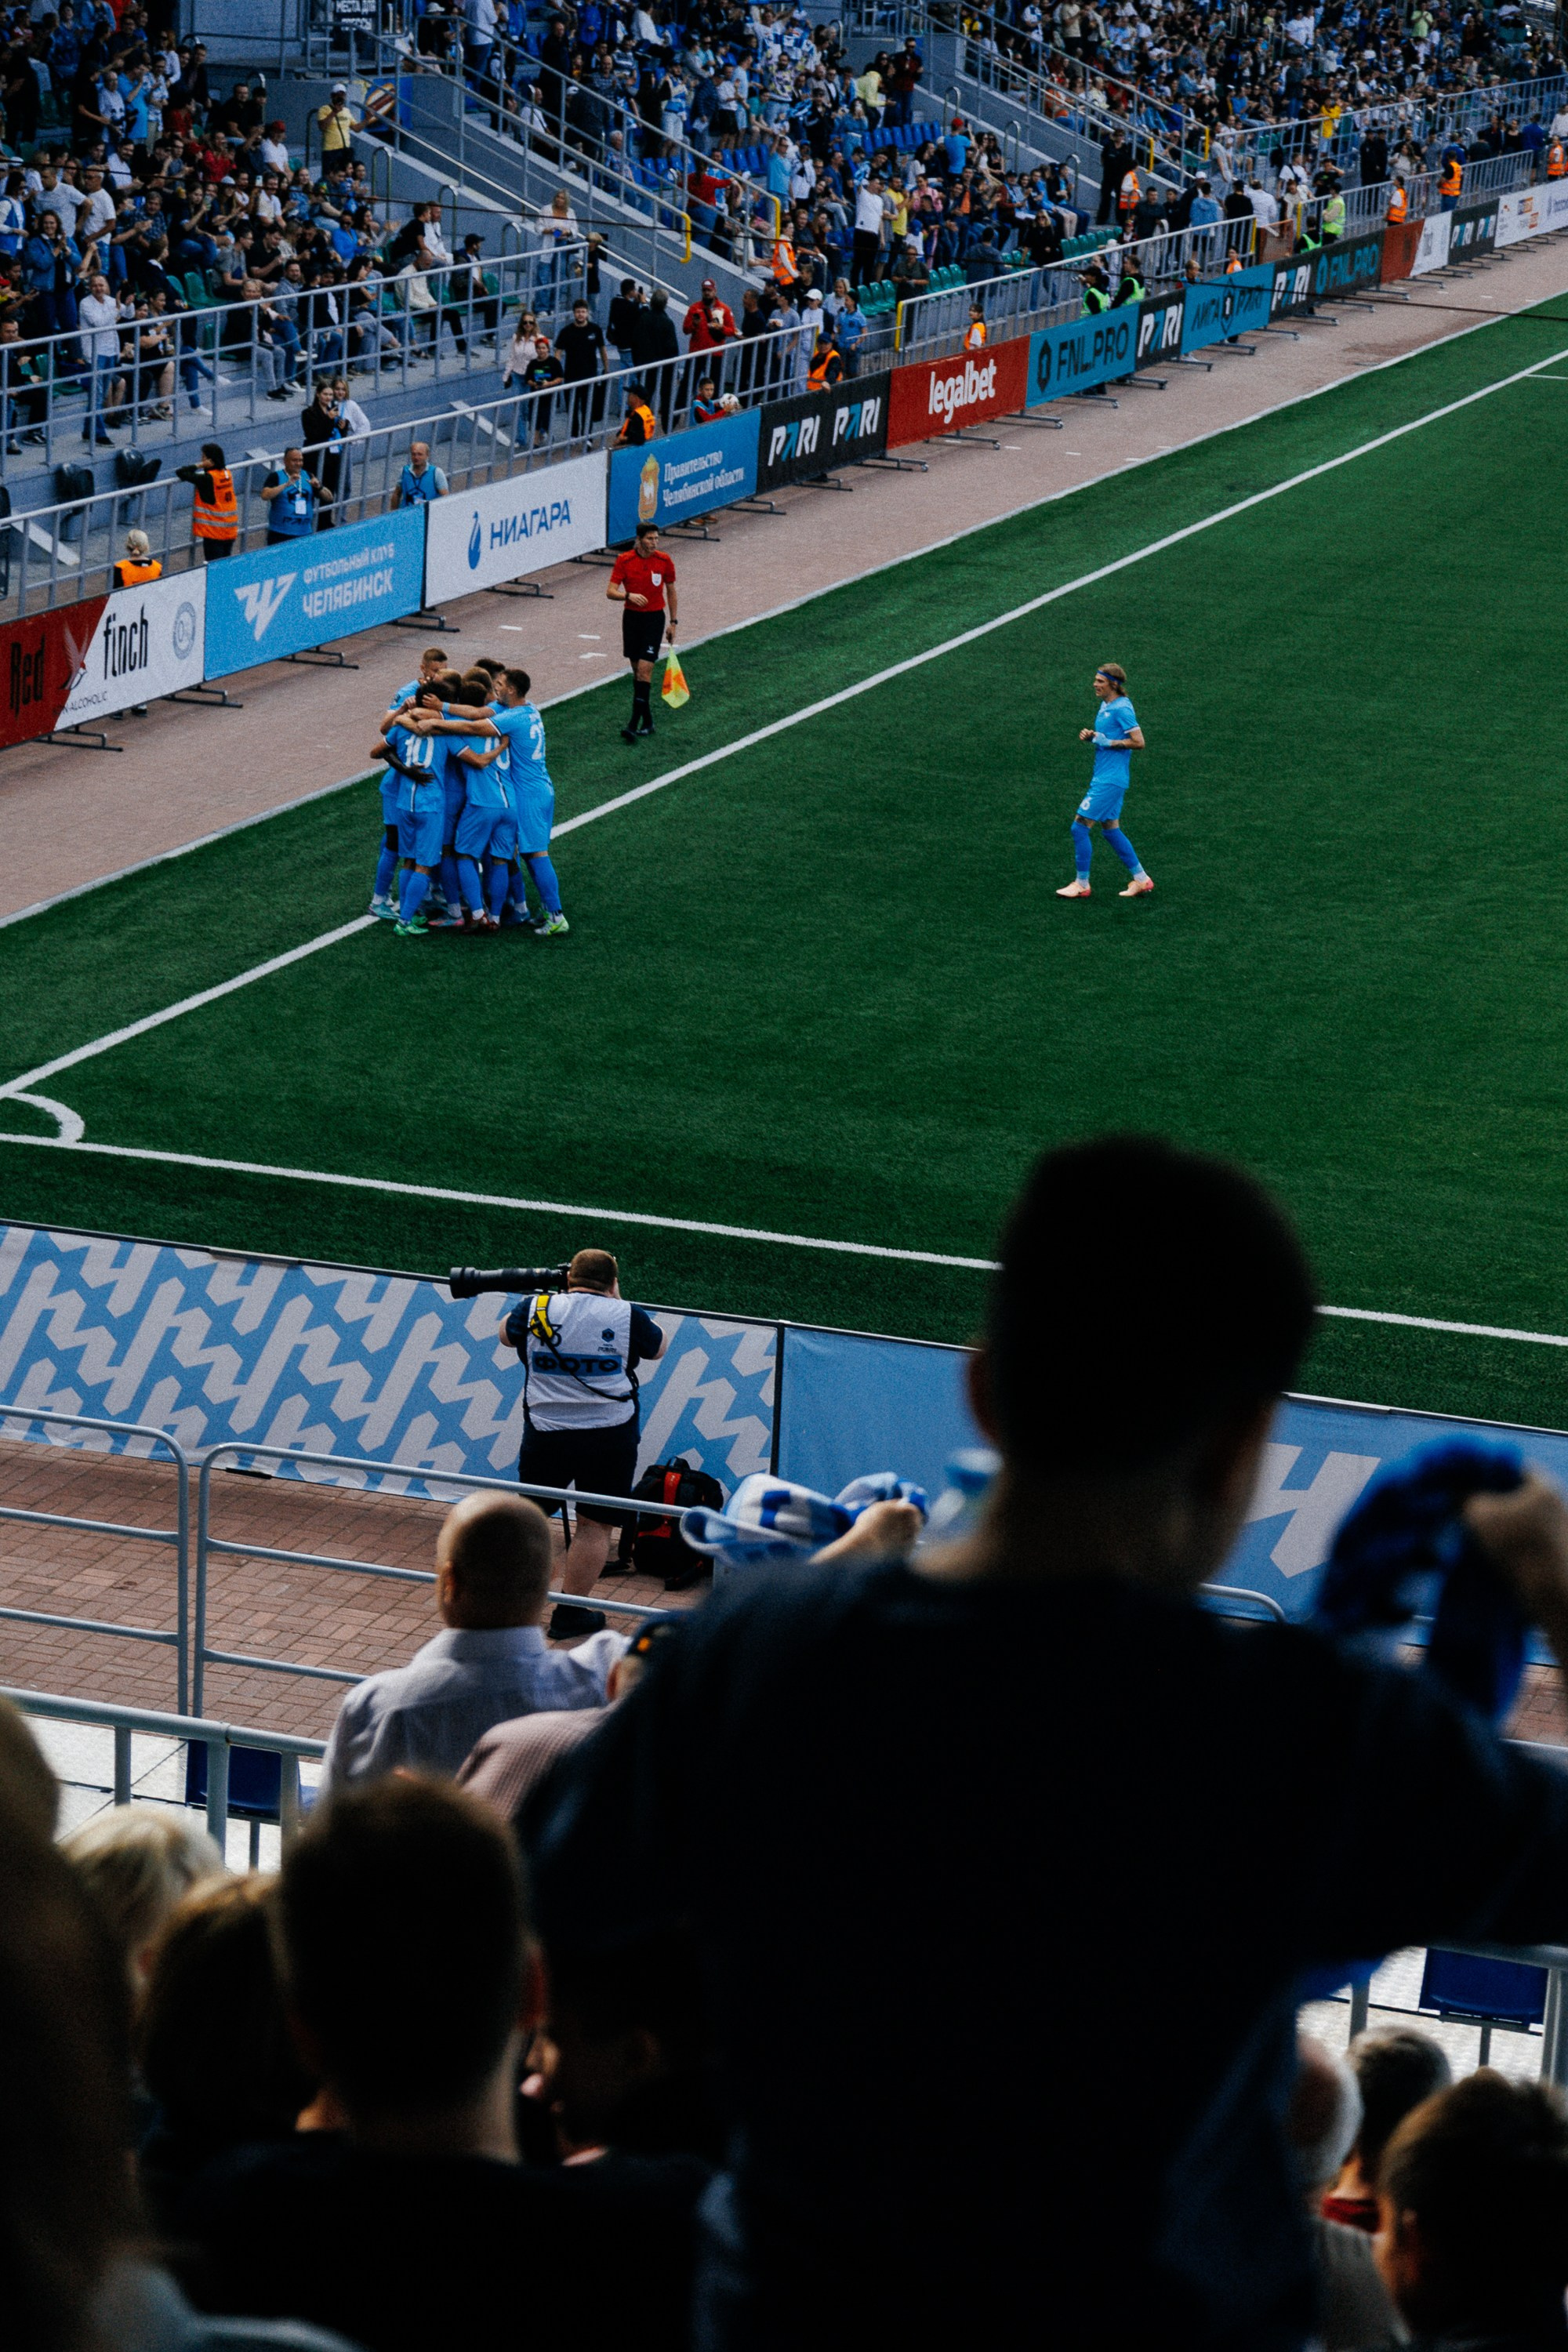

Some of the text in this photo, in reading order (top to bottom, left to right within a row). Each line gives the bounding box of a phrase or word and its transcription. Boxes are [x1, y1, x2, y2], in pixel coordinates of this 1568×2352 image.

[1272, 263, 1312, 311] PARI
[1138, 303, 1183, 358] PARI
[928, 358, 996, 424] legalbet
[768, 414, 821, 466] PARI
[832, 397, 881, 446] PARI
[662, 467, 744, 507] Челябинской области
[664, 450, 723, 485] Правительство
[490, 499, 571, 550] НИАГАРА
[303, 543, 394, 584] ФУТБОЛЬНЫЙ КЛУБ
[303, 568, 394, 619] ЧЕЛЯБИНСК
[9, 632, 45, 720] Red
[103, 603, 148, 680] finch
[405, 734, 434, 769] 10
[535, 1356, 618, 1373] ФОТО
